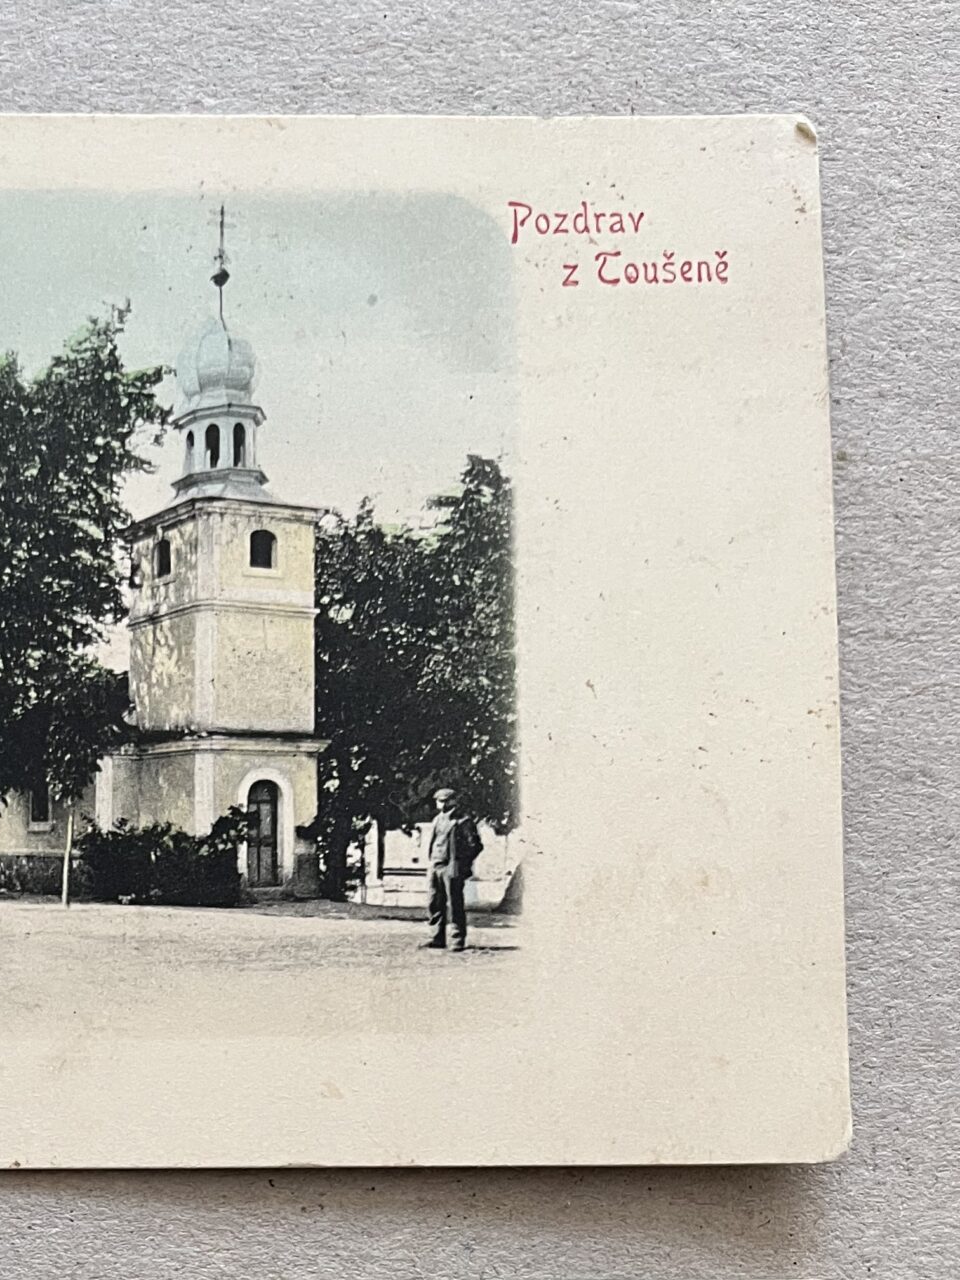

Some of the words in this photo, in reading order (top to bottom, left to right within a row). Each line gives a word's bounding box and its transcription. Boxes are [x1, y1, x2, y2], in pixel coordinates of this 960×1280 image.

[507, 200, 644, 244] Pozdrav
[561, 263, 579, 287] z
[594, 250, 728, 285] Toušeně
